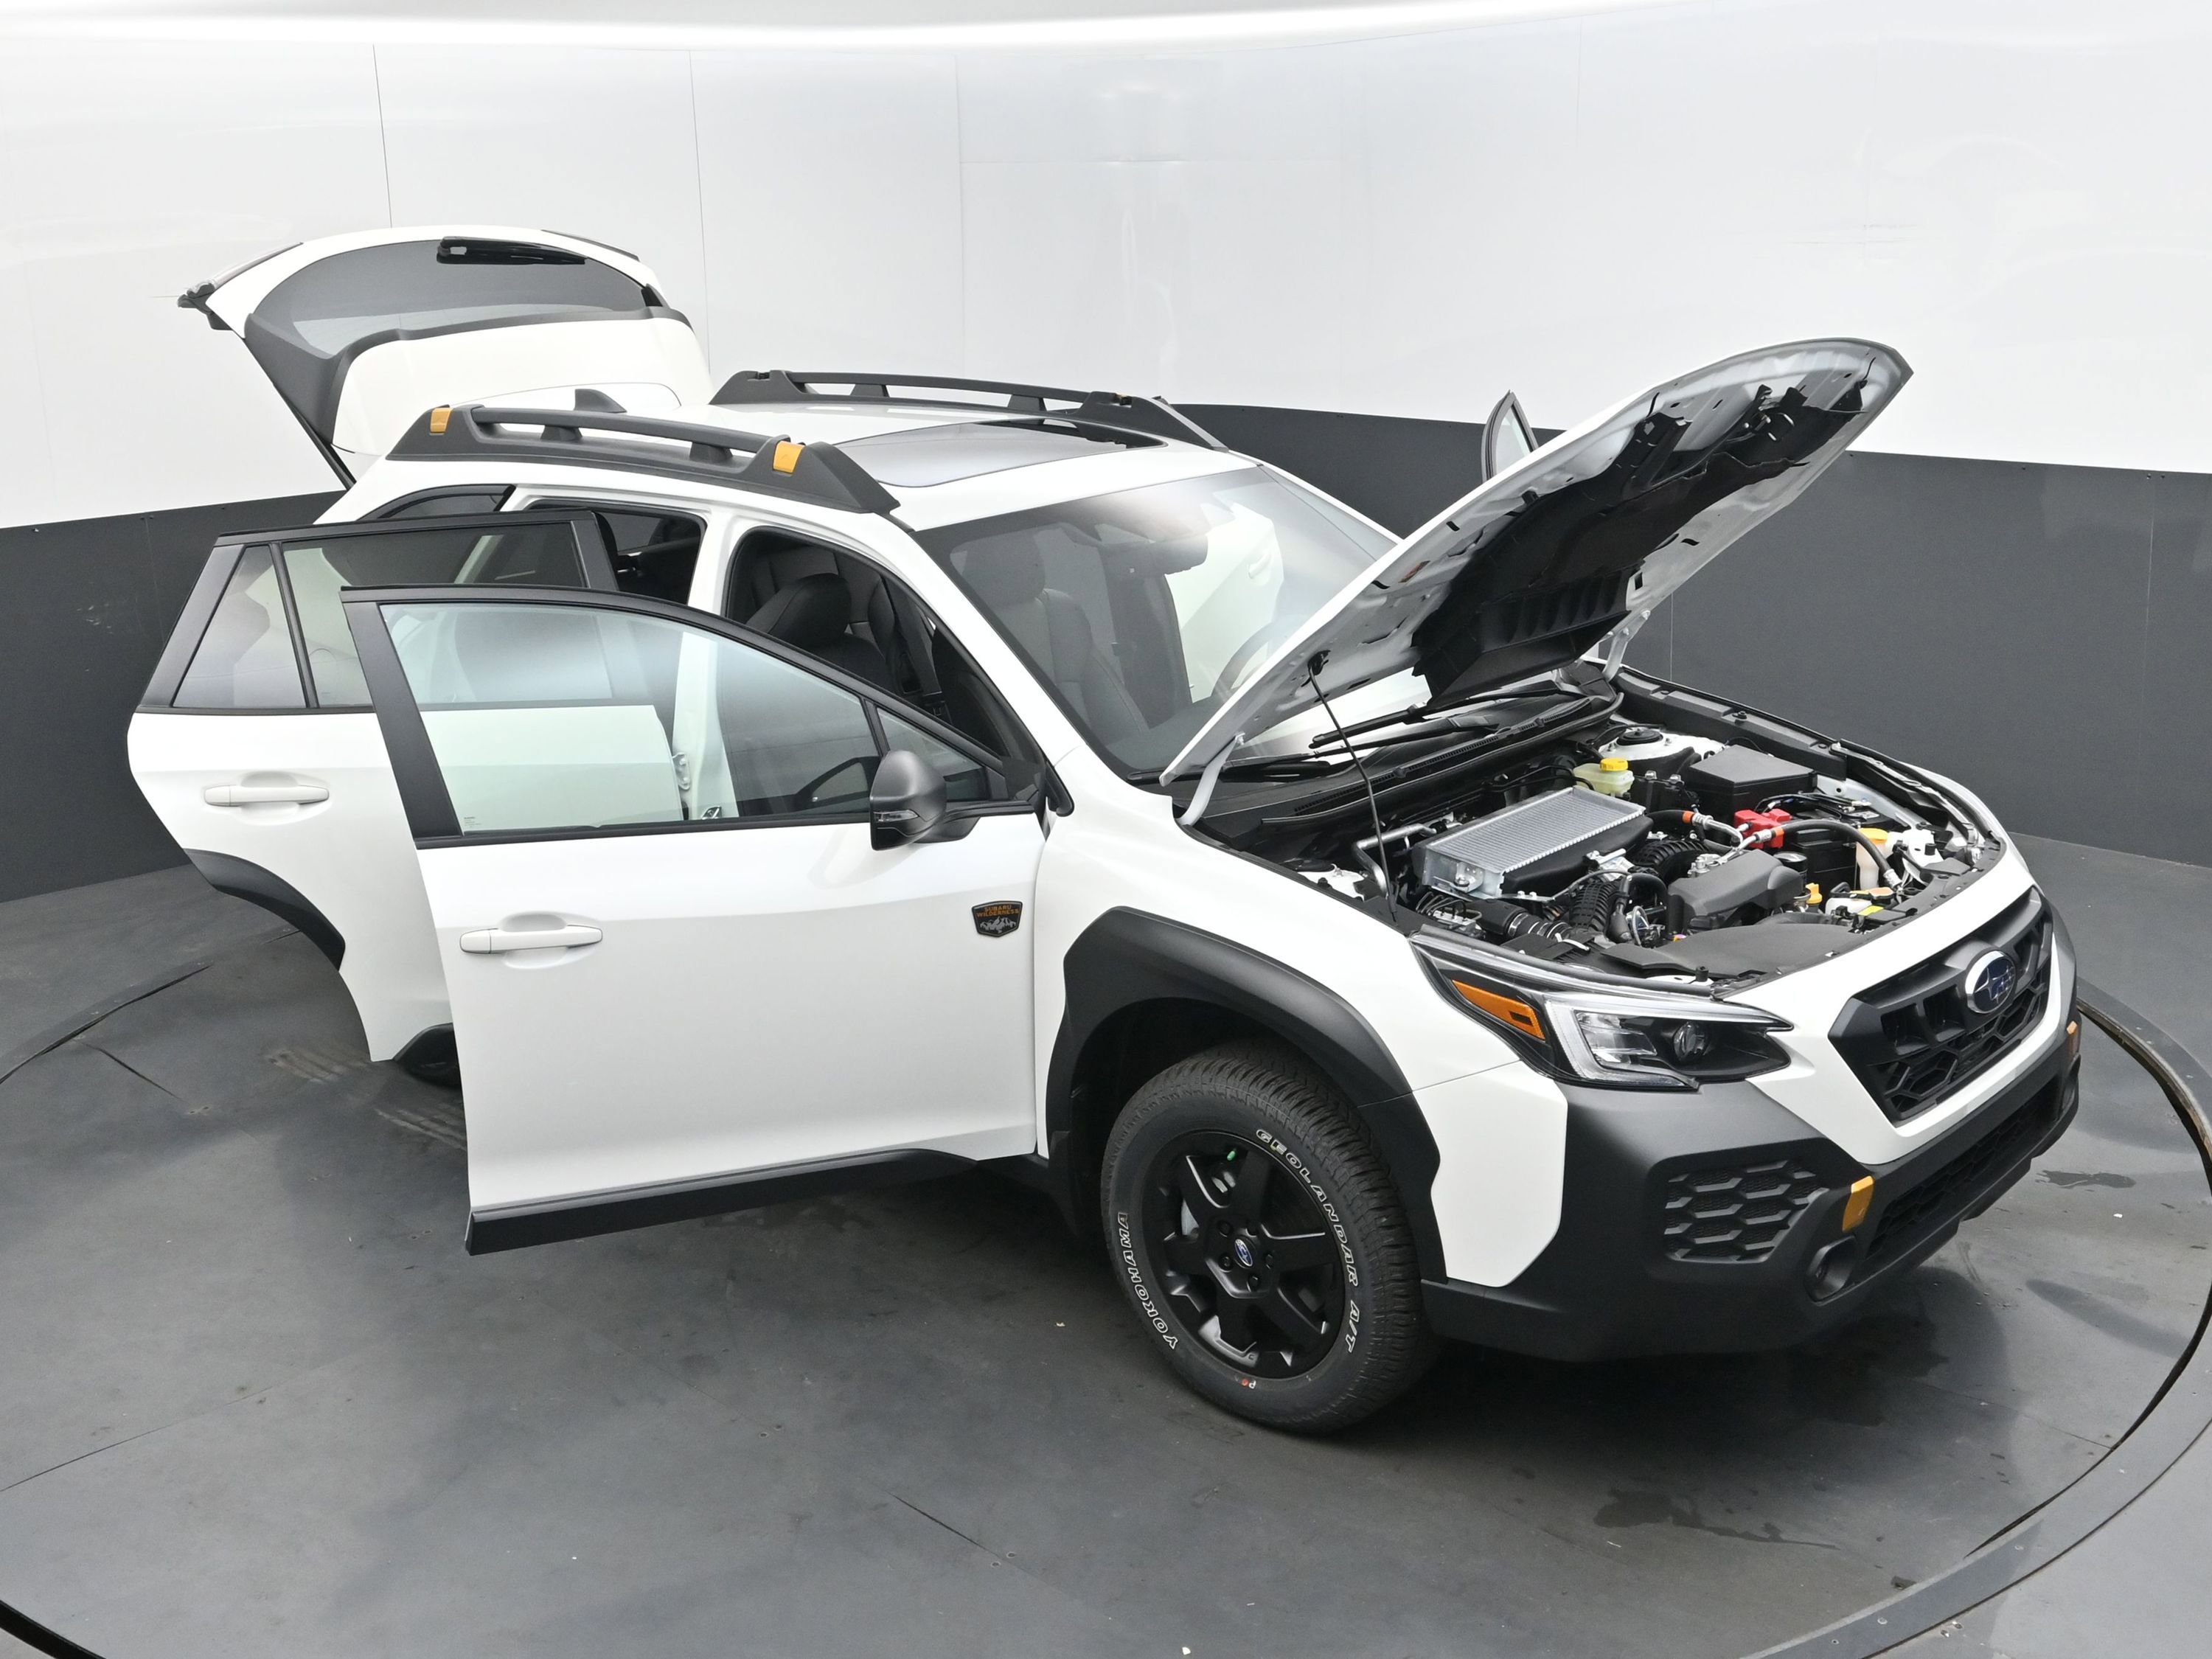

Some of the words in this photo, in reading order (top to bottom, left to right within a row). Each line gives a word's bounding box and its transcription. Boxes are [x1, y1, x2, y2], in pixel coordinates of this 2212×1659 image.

[1118, 1211, 1178, 1349] YOKOHAMA
[1256, 1129, 1358, 1287] GEOLANDAR
[1345, 1299, 1360, 1353] A/T
